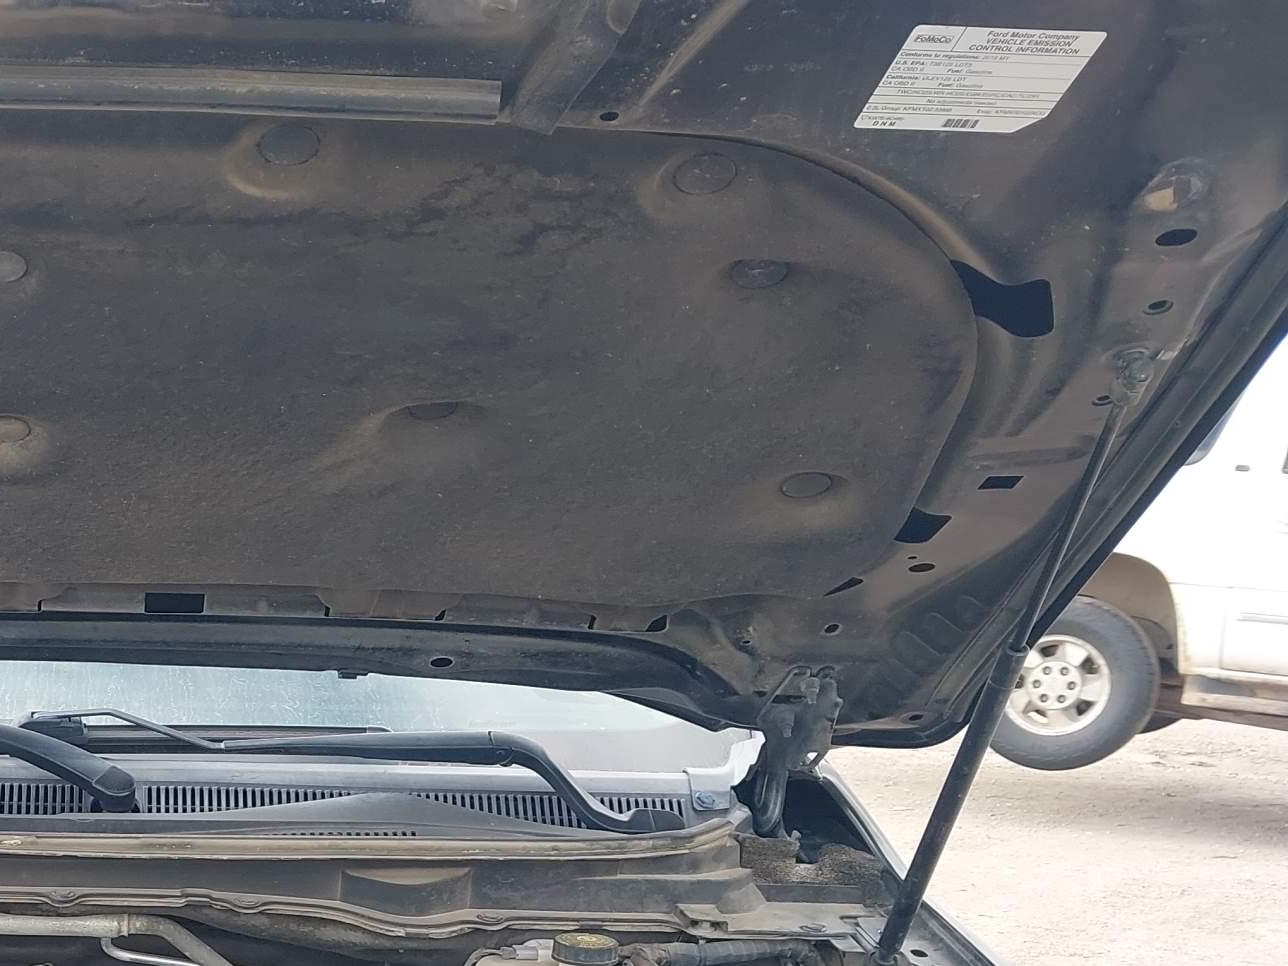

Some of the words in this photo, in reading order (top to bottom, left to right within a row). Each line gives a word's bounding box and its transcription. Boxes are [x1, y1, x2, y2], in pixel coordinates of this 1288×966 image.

[914, 34, 954, 44] FoMoCo
[987, 30, 1009, 38] Ford
[1038, 33, 1080, 41] Company
[986, 37, 1025, 45] VEHICLE
[1027, 39, 1074, 47] EMISSION
[968, 44, 1014, 52] CONTROL
[1015, 46, 1080, 55] INFORMATION
